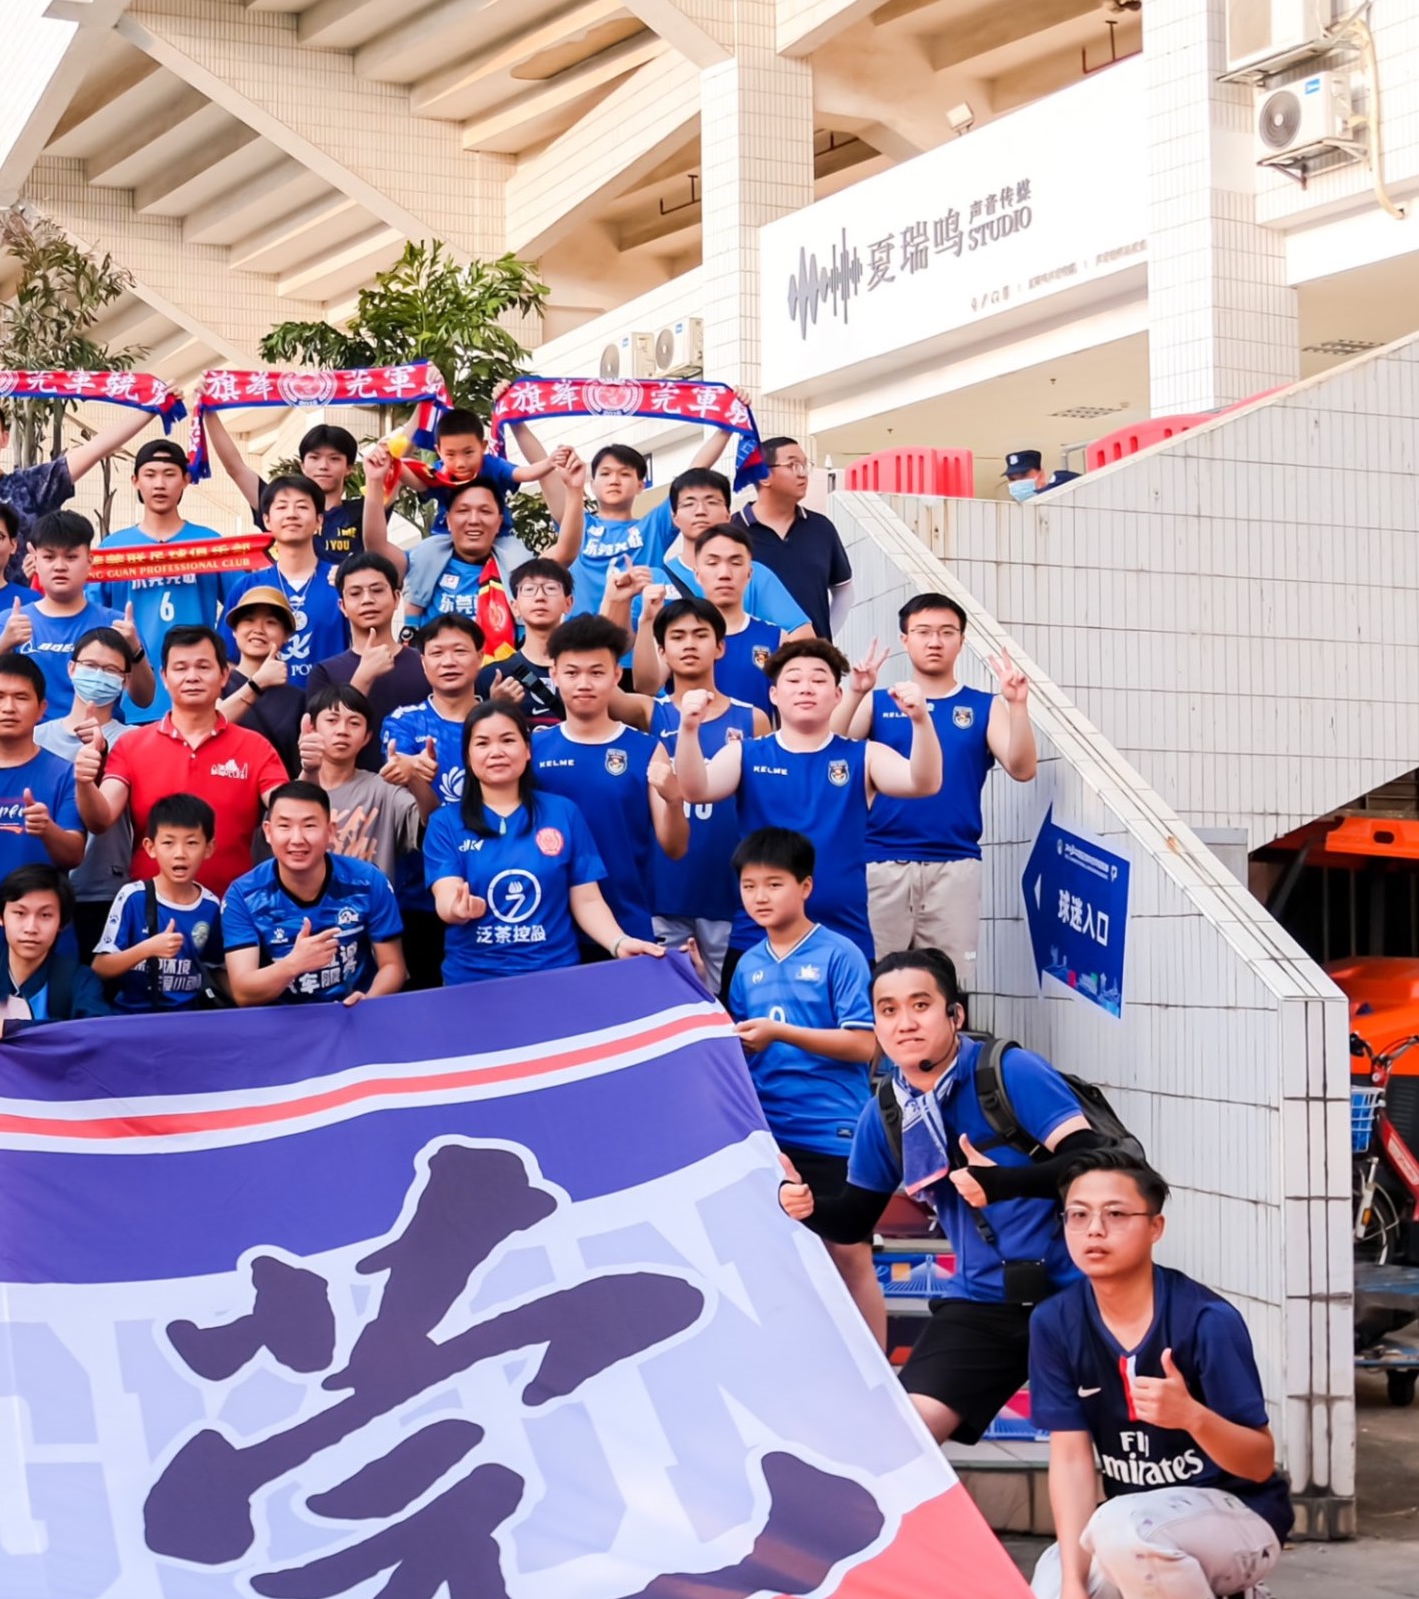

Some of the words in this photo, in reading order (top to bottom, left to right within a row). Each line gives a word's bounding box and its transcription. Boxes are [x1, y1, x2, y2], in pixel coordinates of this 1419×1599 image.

[968, 206, 1032, 252] STUDIO
[867, 208, 964, 292] 夏瑞鸣
[107, 568, 137, 577] GUAN
[140, 562, 219, 574] PROFESSIONAL
[222, 558, 250, 568] CLUB
[160, 591, 175, 621] 6
[37, 642, 75, 653] BOE
[539, 758, 575, 769] KELME
[753, 765, 788, 776] KELME
[1057, 888, 1110, 947] 球迷入口
[1093, 1447, 1204, 1486] mirates
